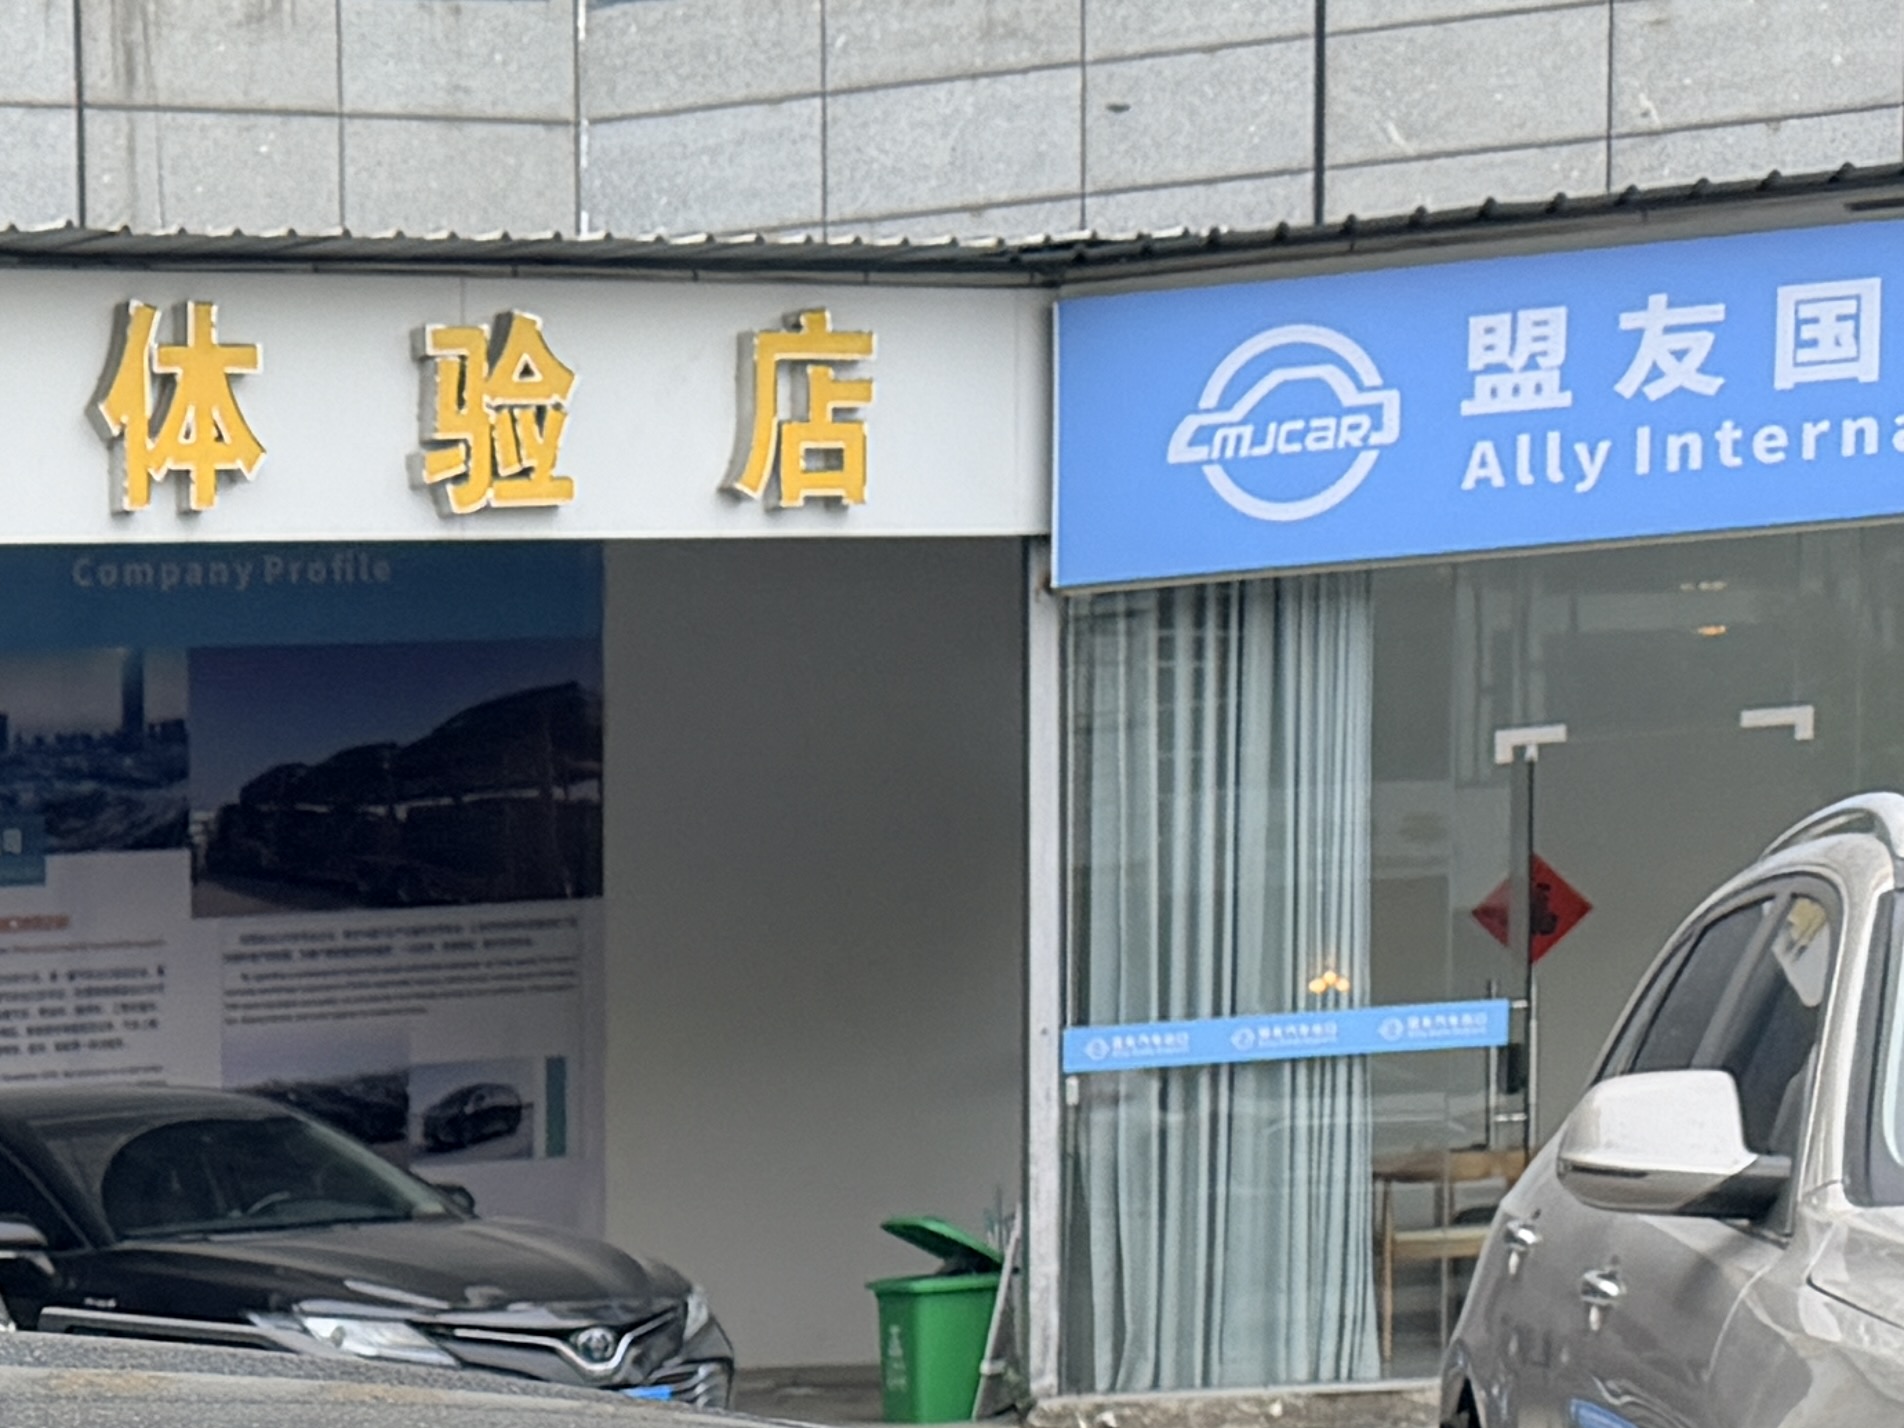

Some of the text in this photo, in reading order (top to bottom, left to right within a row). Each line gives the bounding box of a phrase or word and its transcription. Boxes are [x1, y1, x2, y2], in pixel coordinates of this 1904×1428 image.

[1461, 277, 1883, 417] 盟友国
[1461, 428, 1610, 493] Ally
[71, 549, 394, 592] Company Profile
